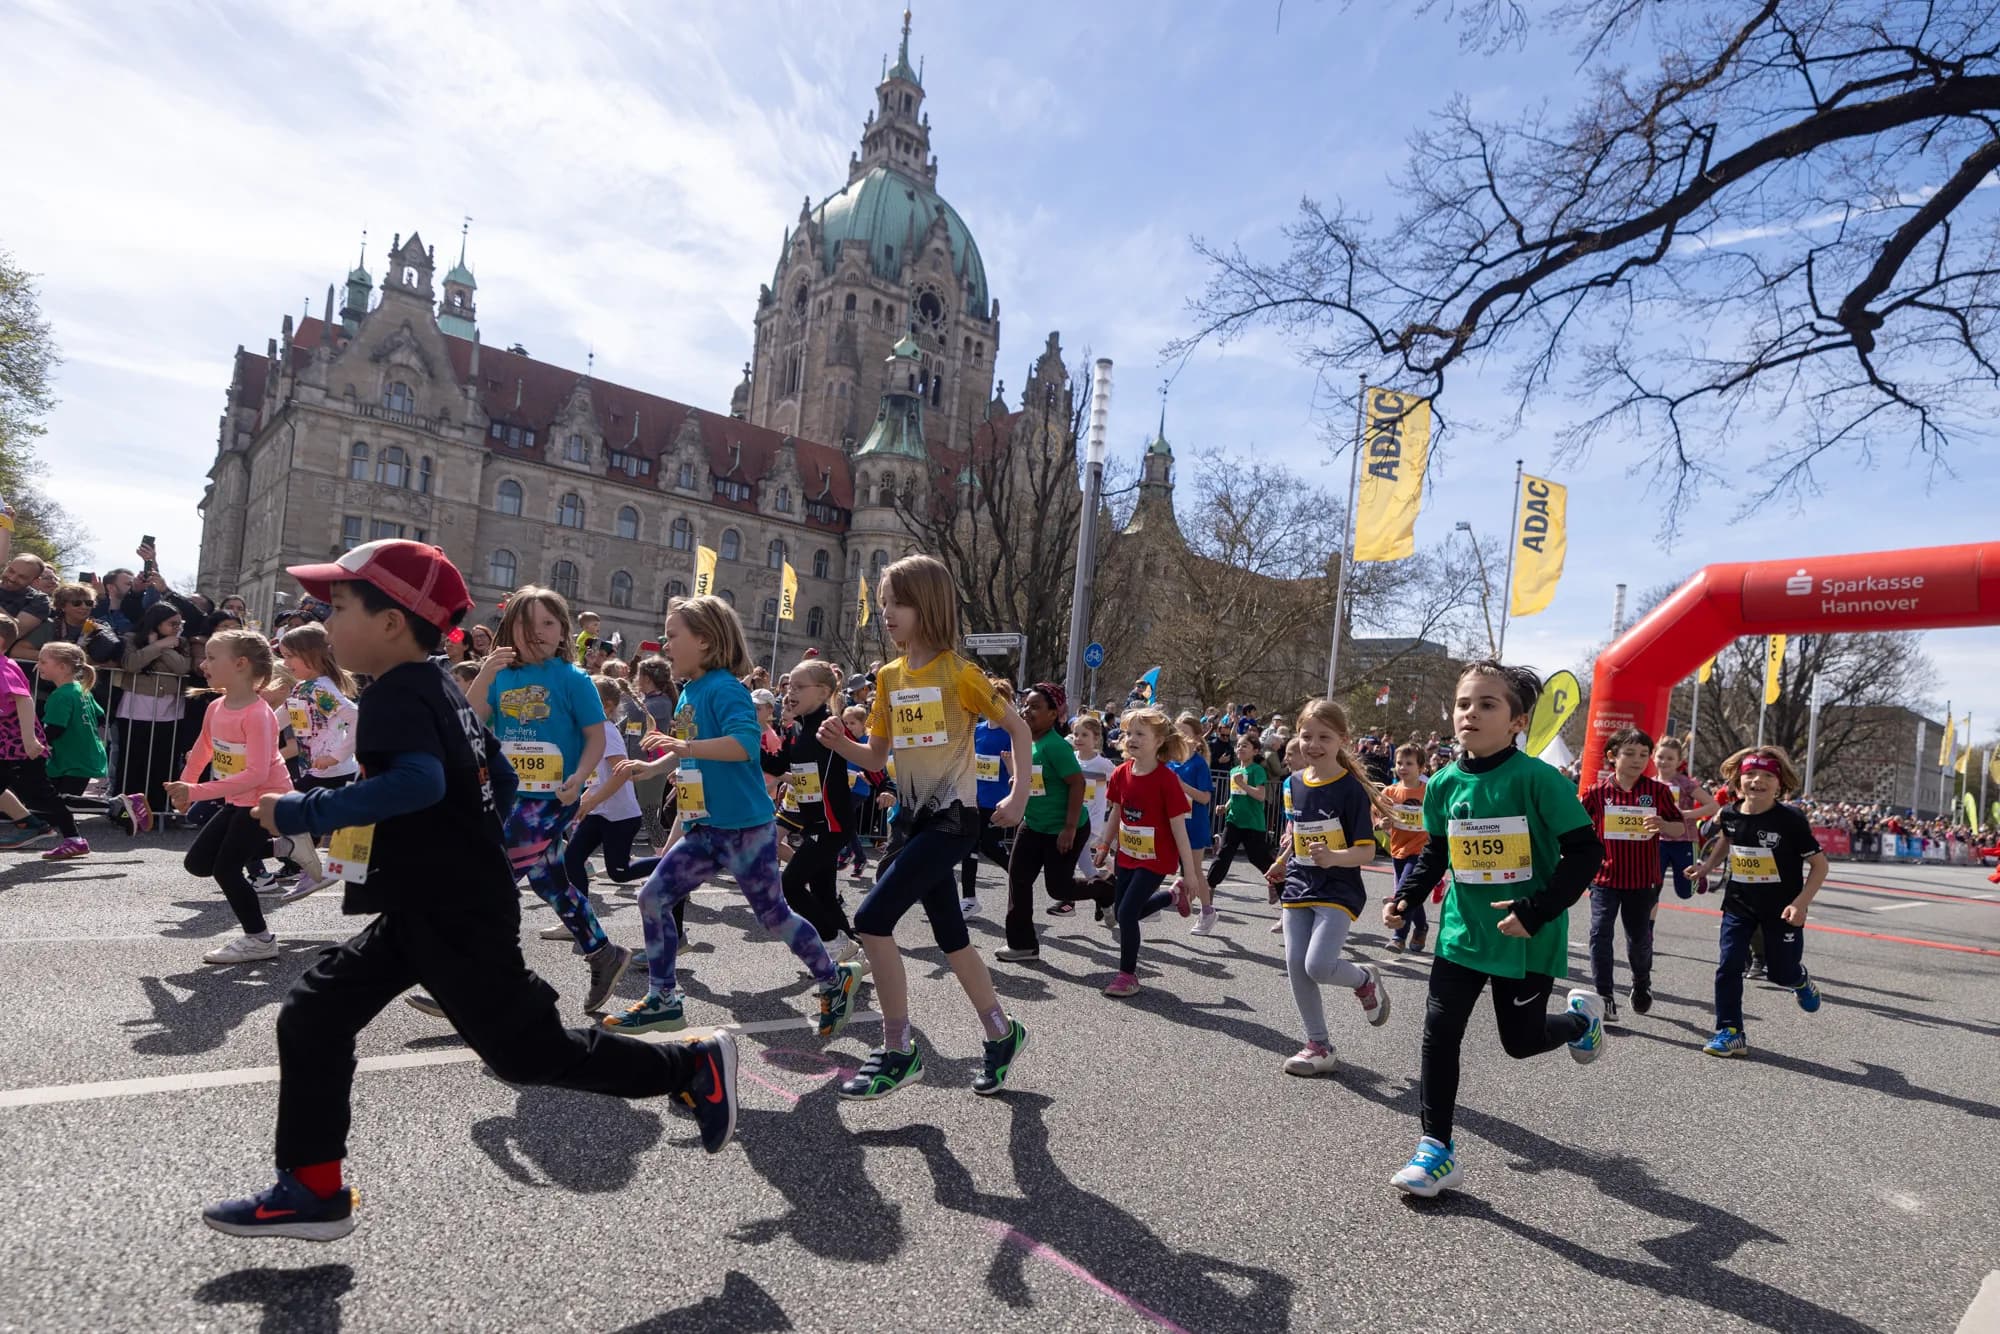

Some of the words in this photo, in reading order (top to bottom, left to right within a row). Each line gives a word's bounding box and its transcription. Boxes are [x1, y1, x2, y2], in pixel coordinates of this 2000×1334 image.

[1368, 392, 1404, 482] ADAC
[1523, 480, 1550, 553] ADAC
[1821, 576, 1925, 596] Sparkasse
[1821, 597, 1920, 613] Hannover
[512, 757, 544, 770] 3198
[1618, 816, 1644, 826] 3233
[1462, 839, 1504, 855] 3159
[1472, 859, 1497, 869] Diego
